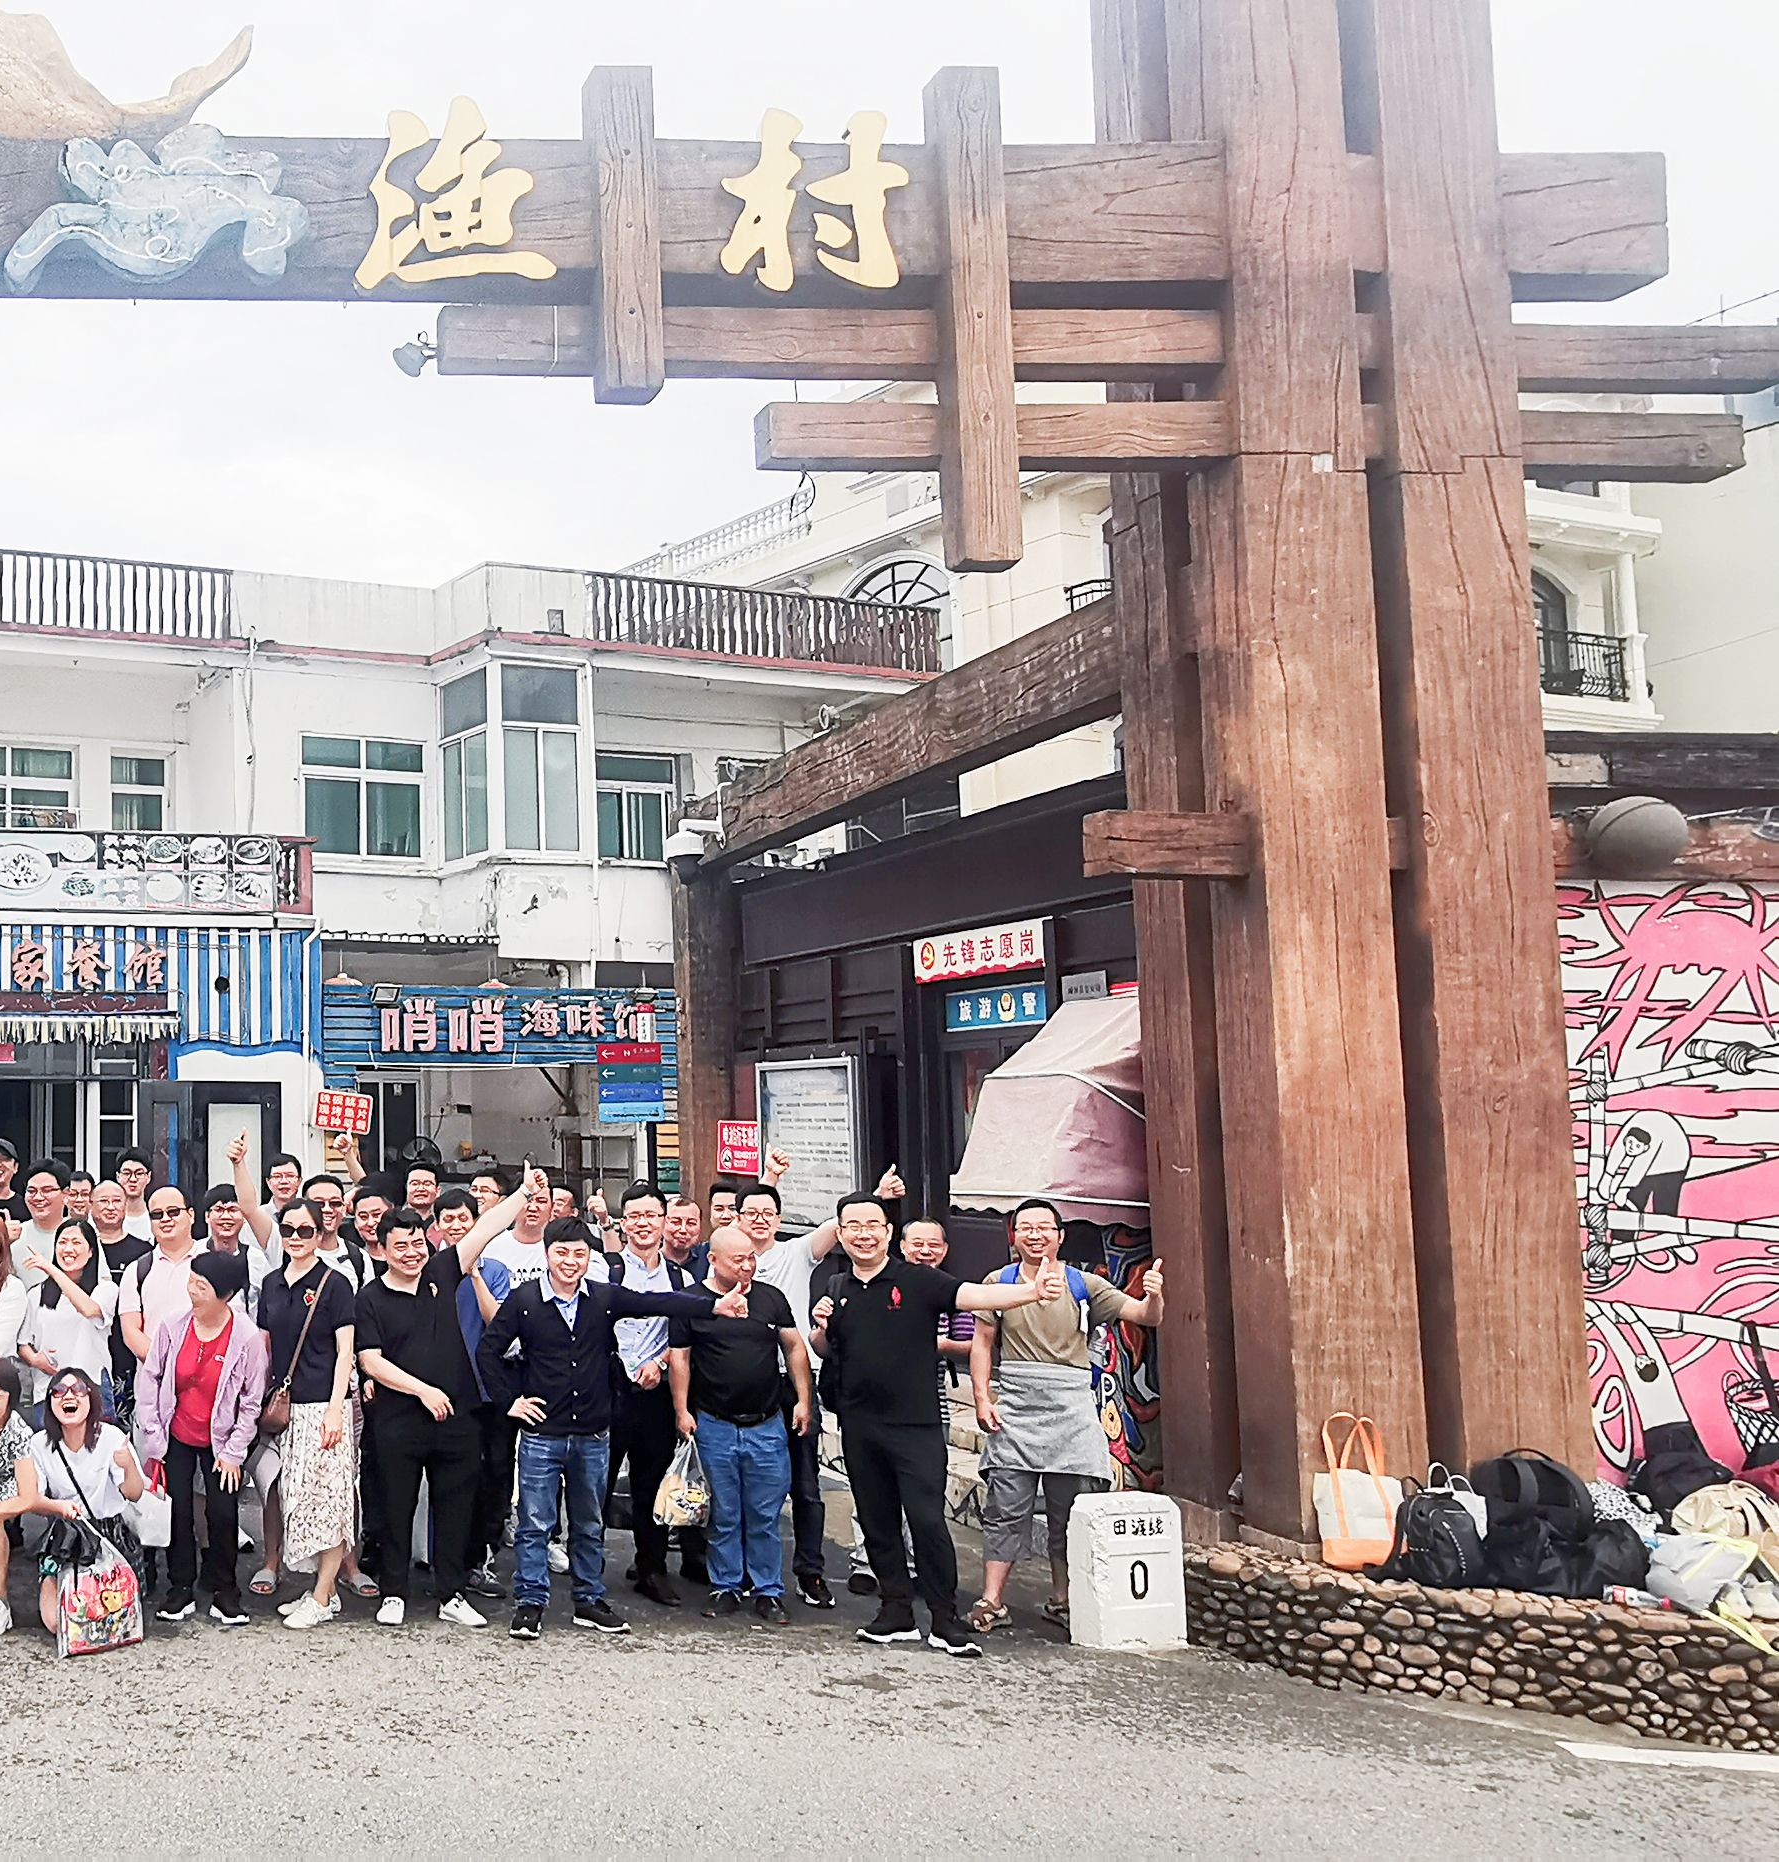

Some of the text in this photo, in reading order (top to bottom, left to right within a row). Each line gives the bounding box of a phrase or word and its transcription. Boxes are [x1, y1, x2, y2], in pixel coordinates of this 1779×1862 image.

[942, 928, 1034, 968] 先锋志愿岗
[1129, 1559, 1149, 1600] 0
